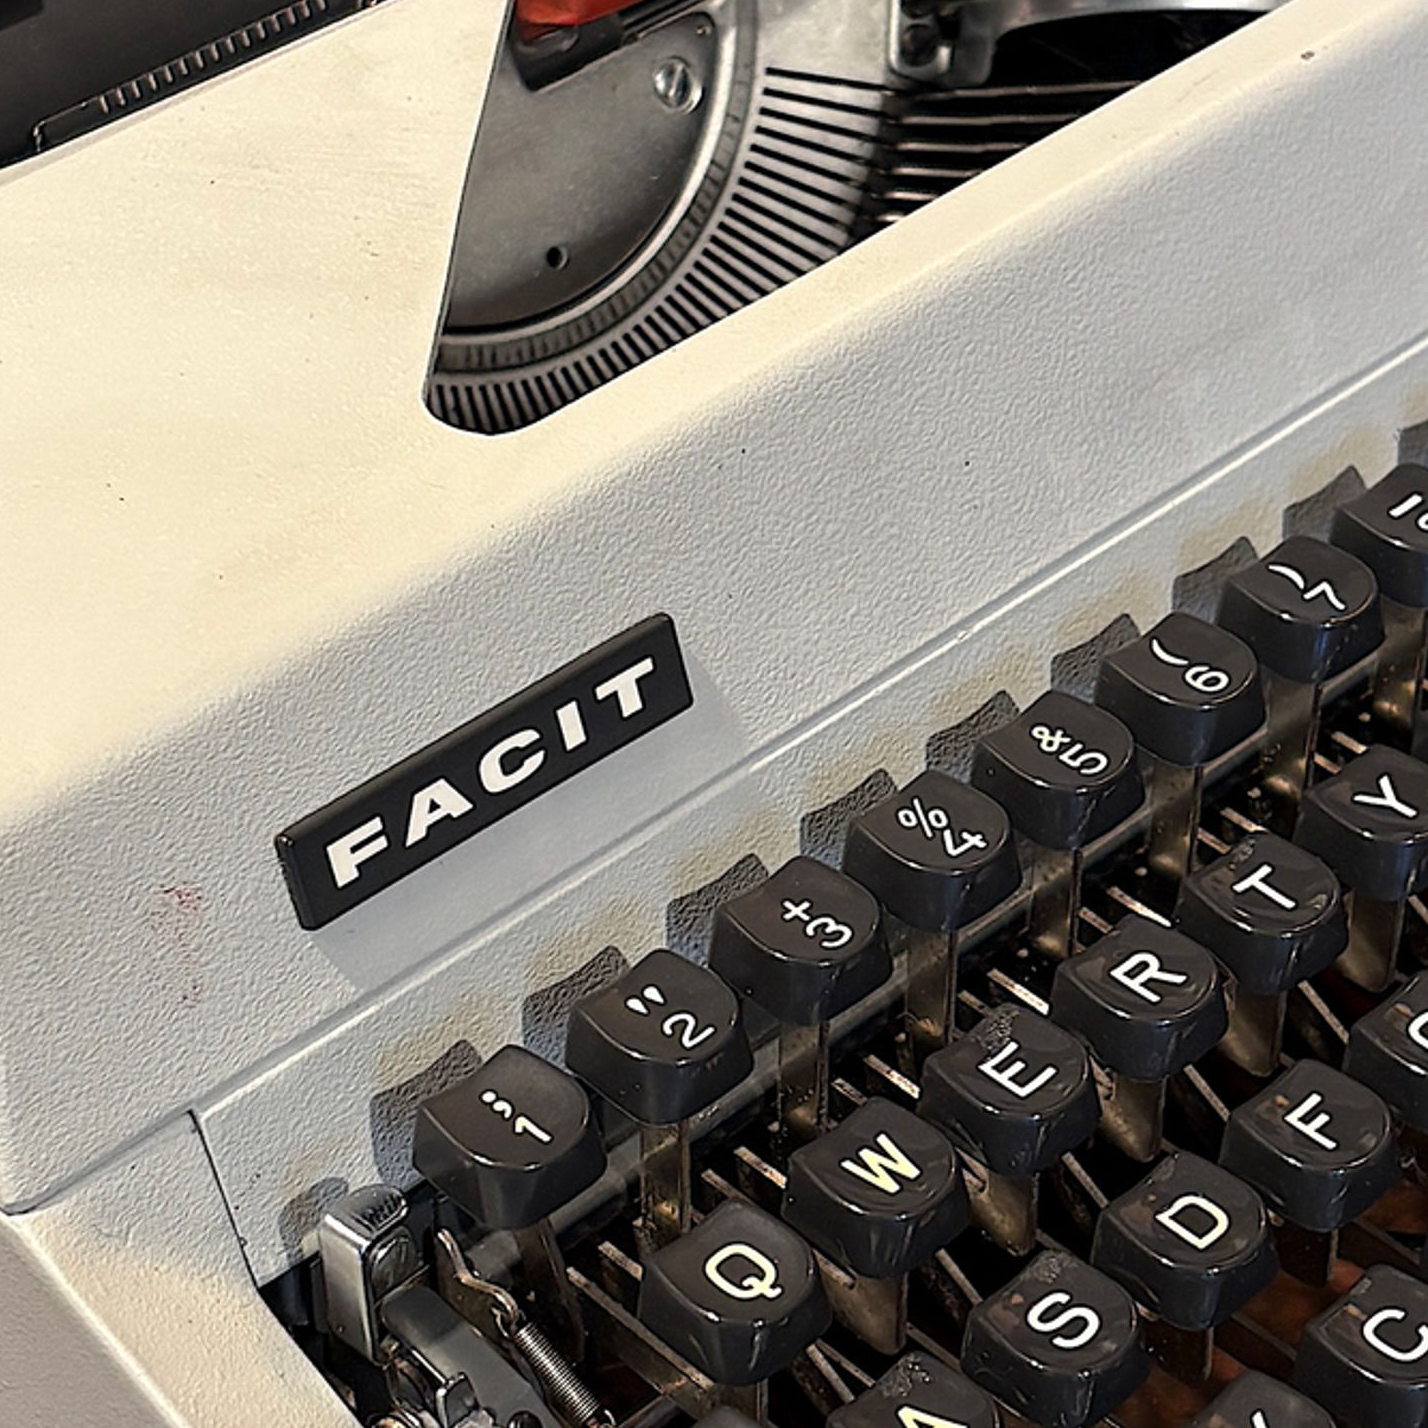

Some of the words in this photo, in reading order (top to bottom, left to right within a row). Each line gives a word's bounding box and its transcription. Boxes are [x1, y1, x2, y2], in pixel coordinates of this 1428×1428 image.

[1302, 580, 1347, 611] 7
[1183, 665, 1230, 693] 6
[325, 656, 655, 889] FACIT
[1057, 742, 1109, 775] 5
[896, 796, 949, 838] %
[1352, 774, 1418, 818] Y
[942, 828, 988, 858] 4
[1231, 863, 1297, 910] T
[805, 916, 853, 949] 3
[1109, 951, 1188, 1004] R
[661, 1012, 716, 1049] 2
[977, 1040, 1058, 1098] E
[514, 1115, 552, 1143] 1
[1283, 1092, 1338, 1151] F
[840, 1132, 922, 1194] W
[1154, 1194, 1230, 1250] D
[704, 1242, 783, 1299] Q
[1026, 1291, 1101, 1349] S
